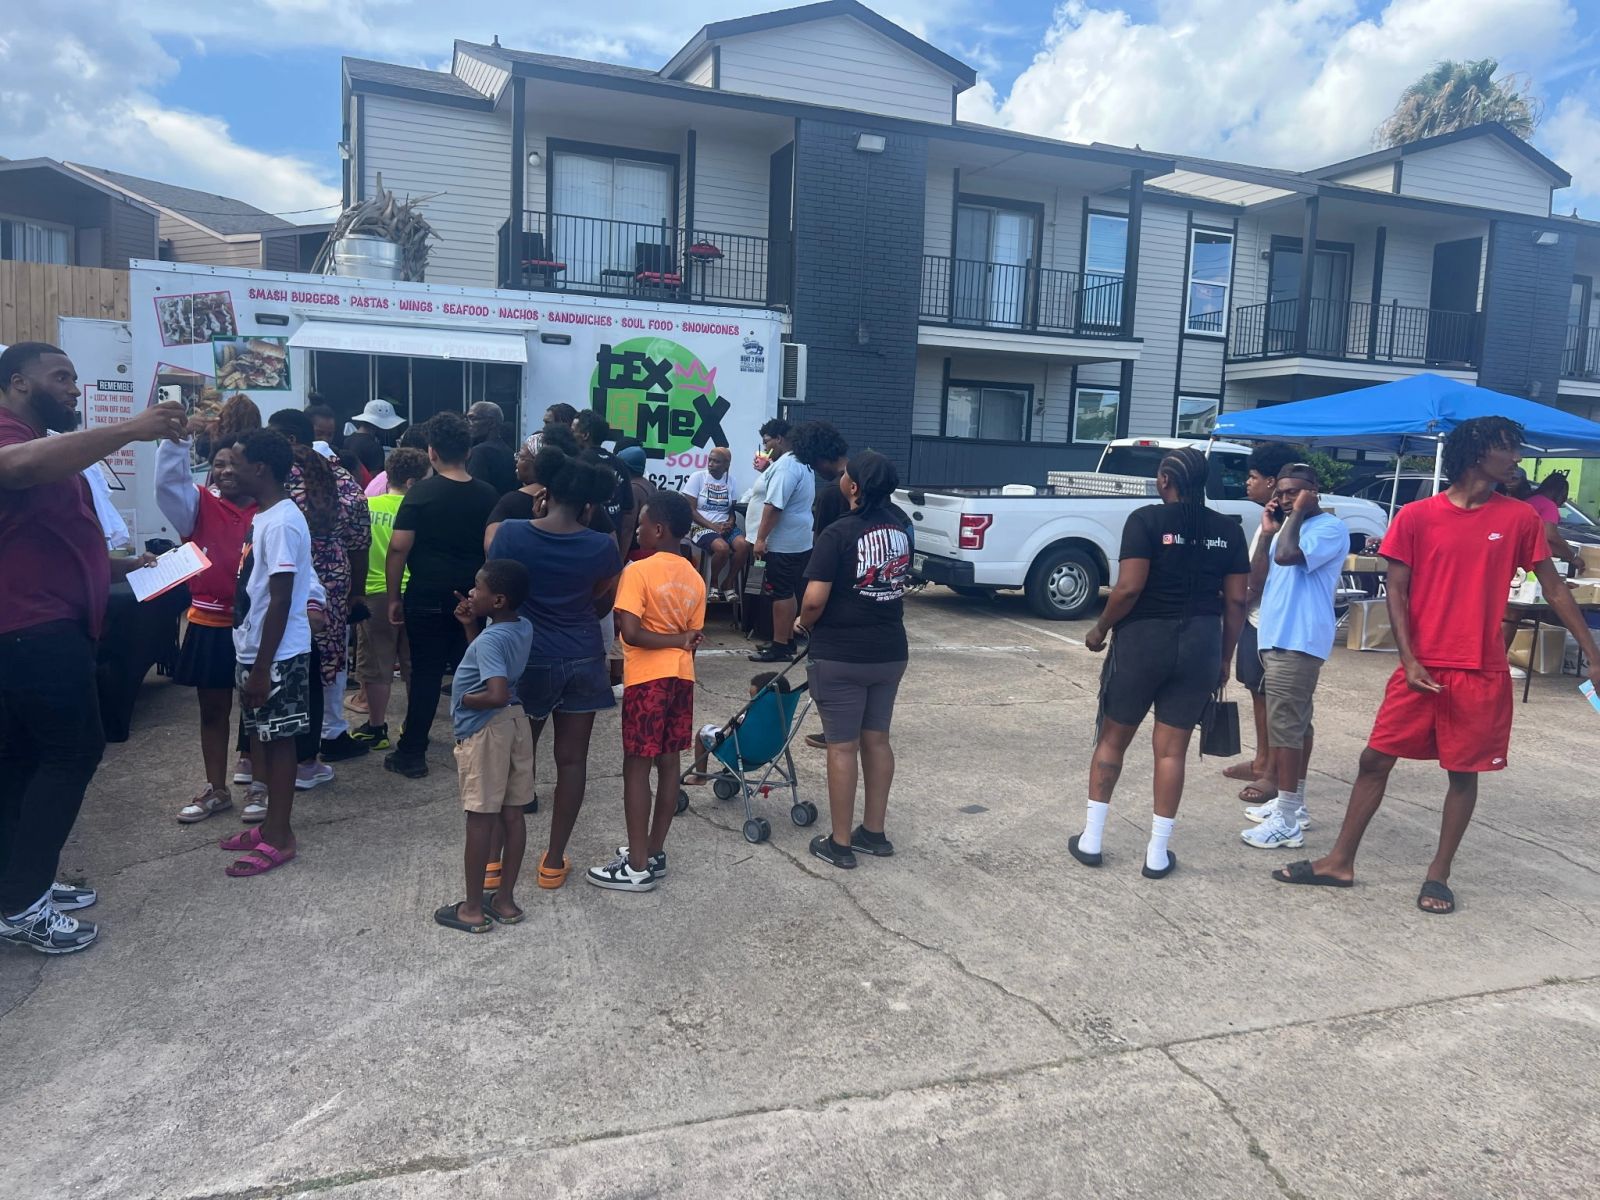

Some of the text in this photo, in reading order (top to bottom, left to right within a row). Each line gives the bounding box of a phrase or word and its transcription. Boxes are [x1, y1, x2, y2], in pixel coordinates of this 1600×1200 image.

[248, 288, 740, 336] SMASH BURGERS PASTAS WINGS SEAFOOD NACHOS SANDWICHES SOUL FOOD SNOWCONES
